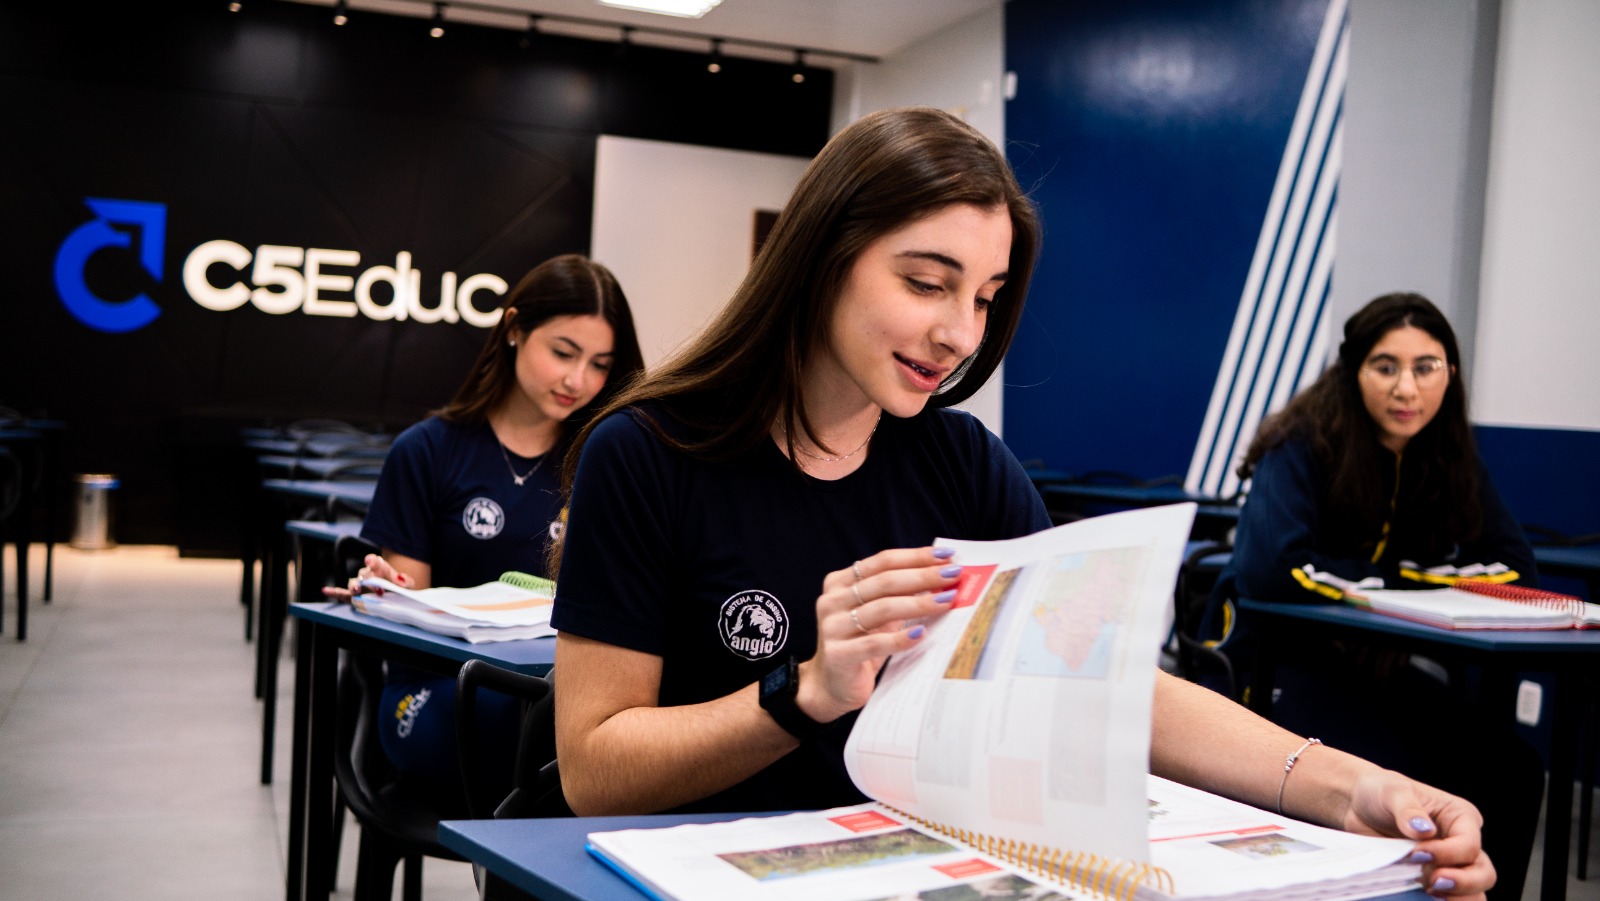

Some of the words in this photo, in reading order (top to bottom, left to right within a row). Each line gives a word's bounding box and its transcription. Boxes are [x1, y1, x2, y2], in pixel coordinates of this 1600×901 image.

[182, 239, 508, 328] C5Educ
[754, 594, 764, 603] DE
[730, 635, 774, 656] anglo
